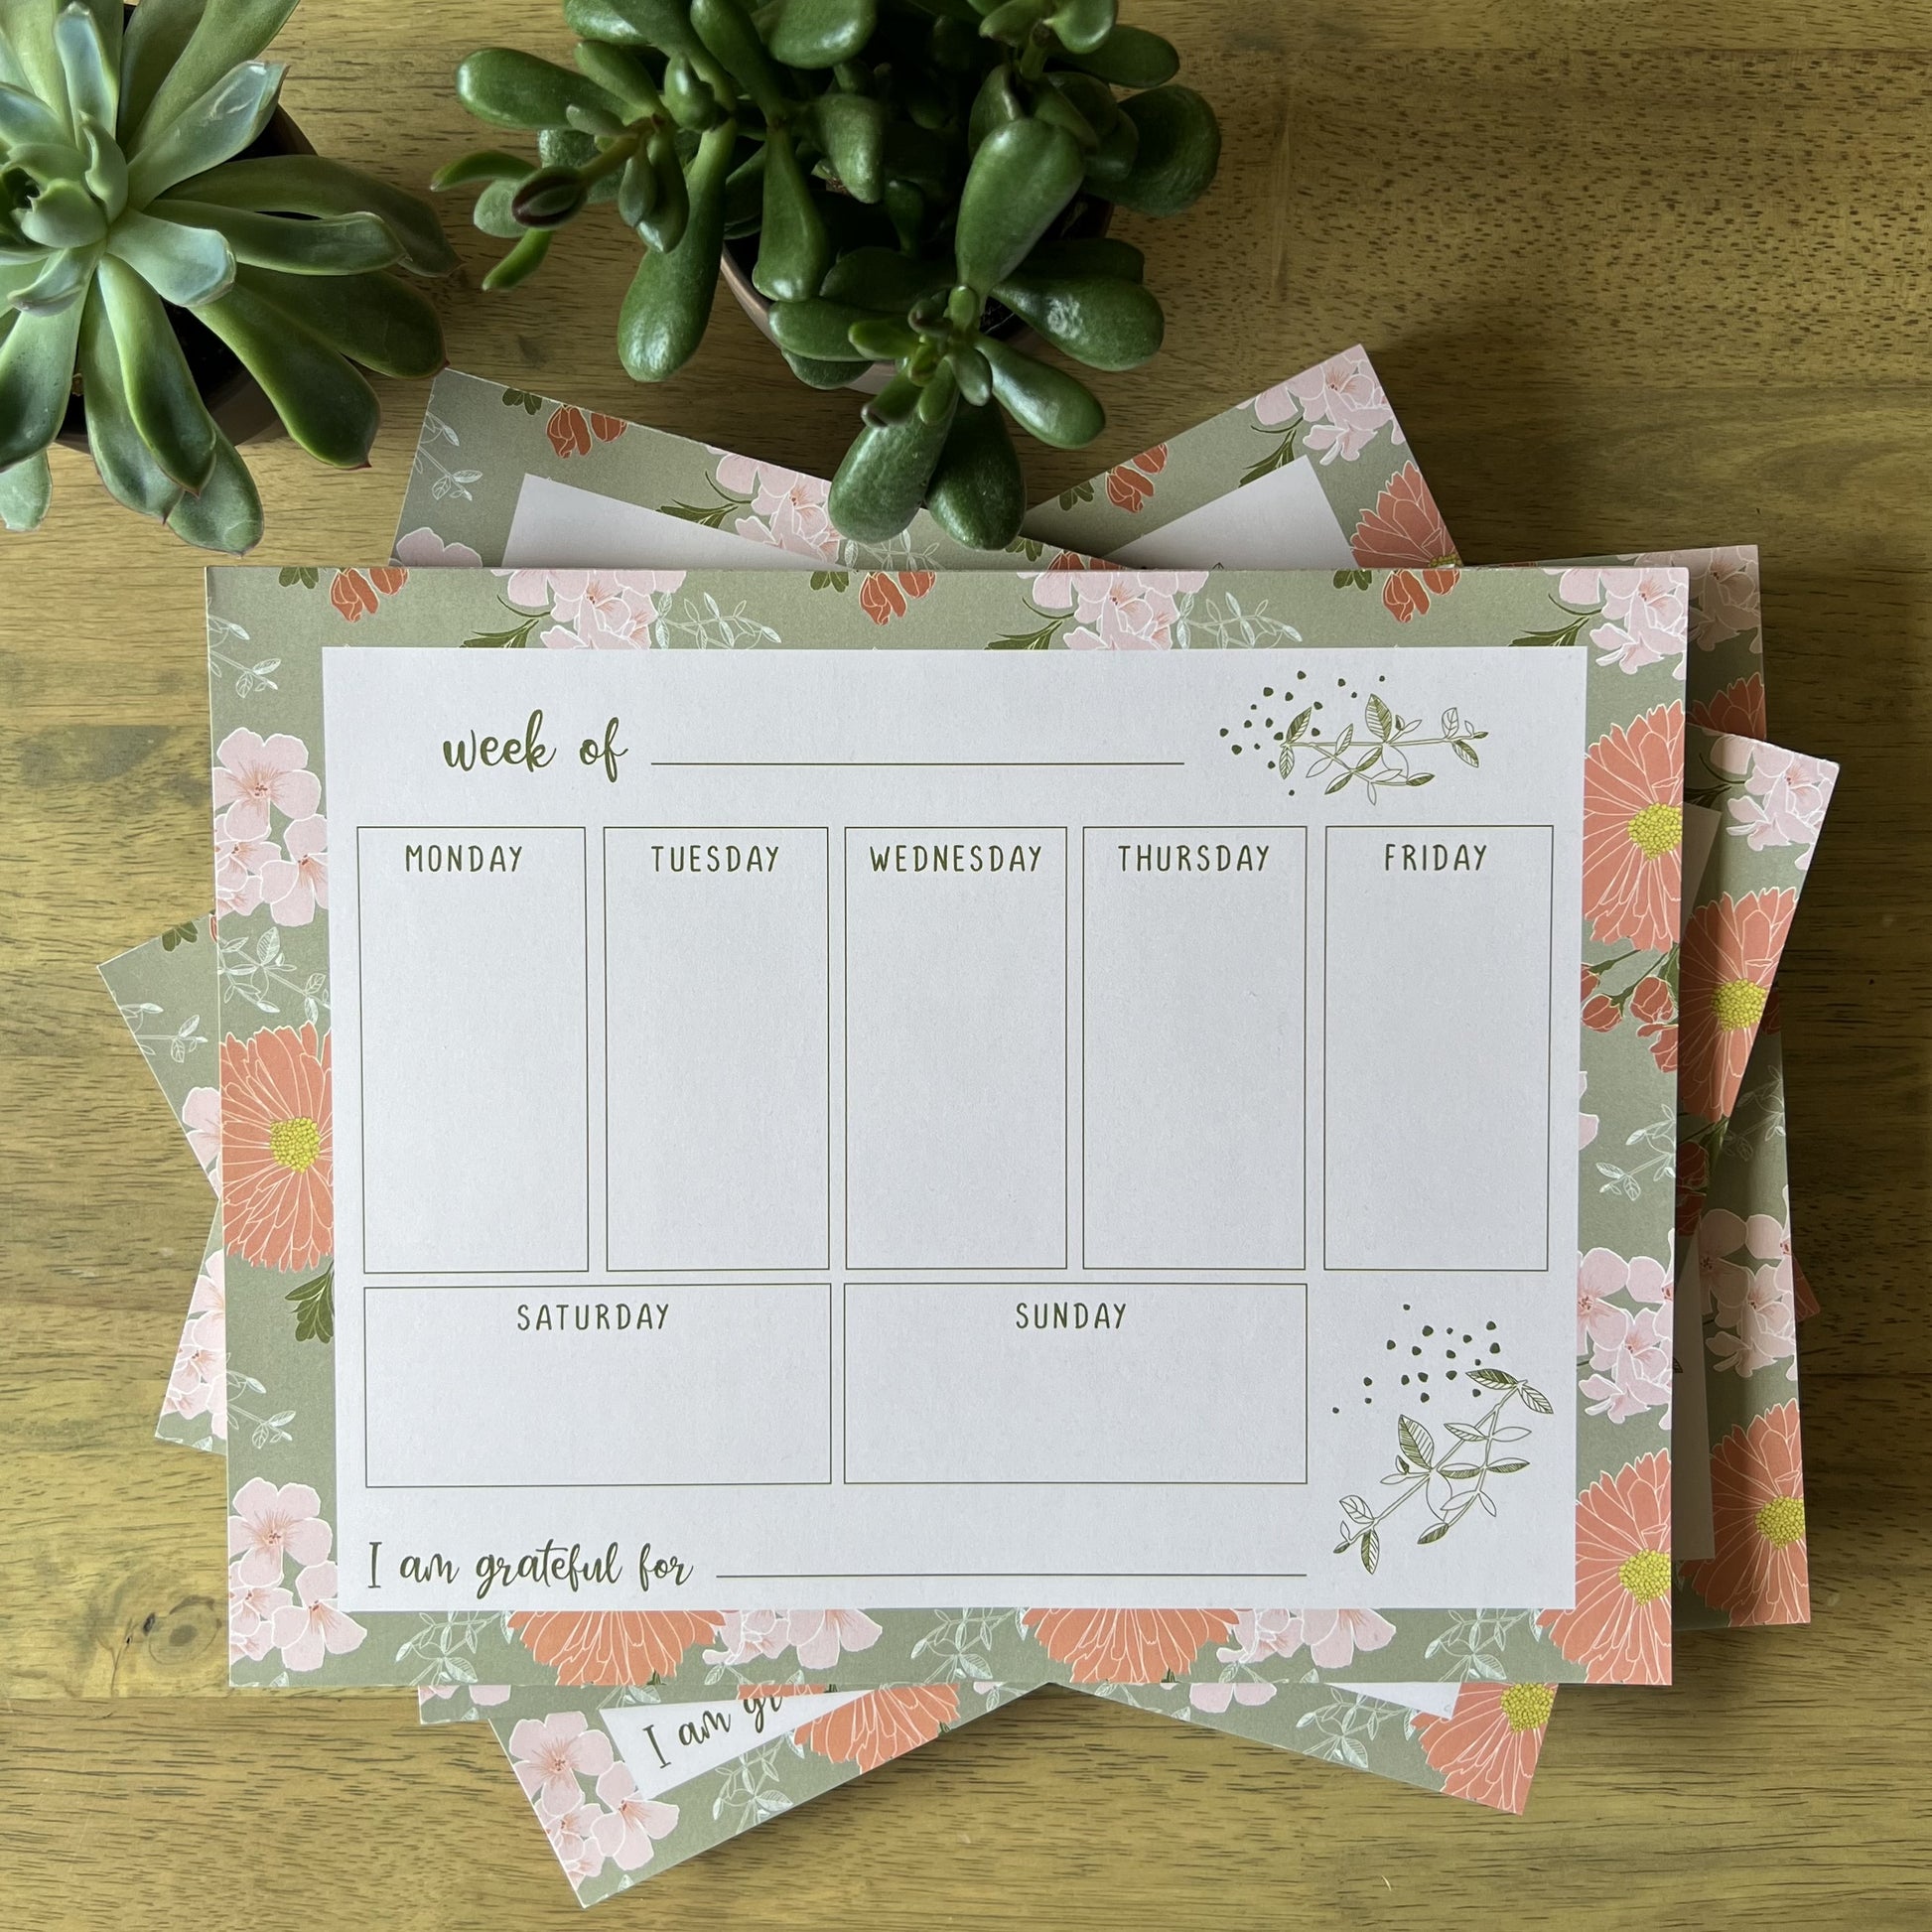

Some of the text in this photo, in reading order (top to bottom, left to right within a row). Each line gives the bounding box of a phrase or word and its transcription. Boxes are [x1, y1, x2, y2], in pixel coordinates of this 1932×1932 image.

[442, 708, 629, 783] week of
[405, 844, 523, 874] MONDAY
[650, 844, 780, 874] TUESDAY
[869, 844, 1043, 874] WEDNESDAY
[1117, 843, 1271, 873] THURSDAY
[1384, 843, 1488, 873] FRIDAY
[516, 1303, 670, 1332] SATURDAY
[1016, 1301, 1128, 1330] SUNDAY
[367, 1538, 695, 1600] I am grateful for
[642, 1724, 672, 1769] I
[678, 1710, 732, 1746] am
